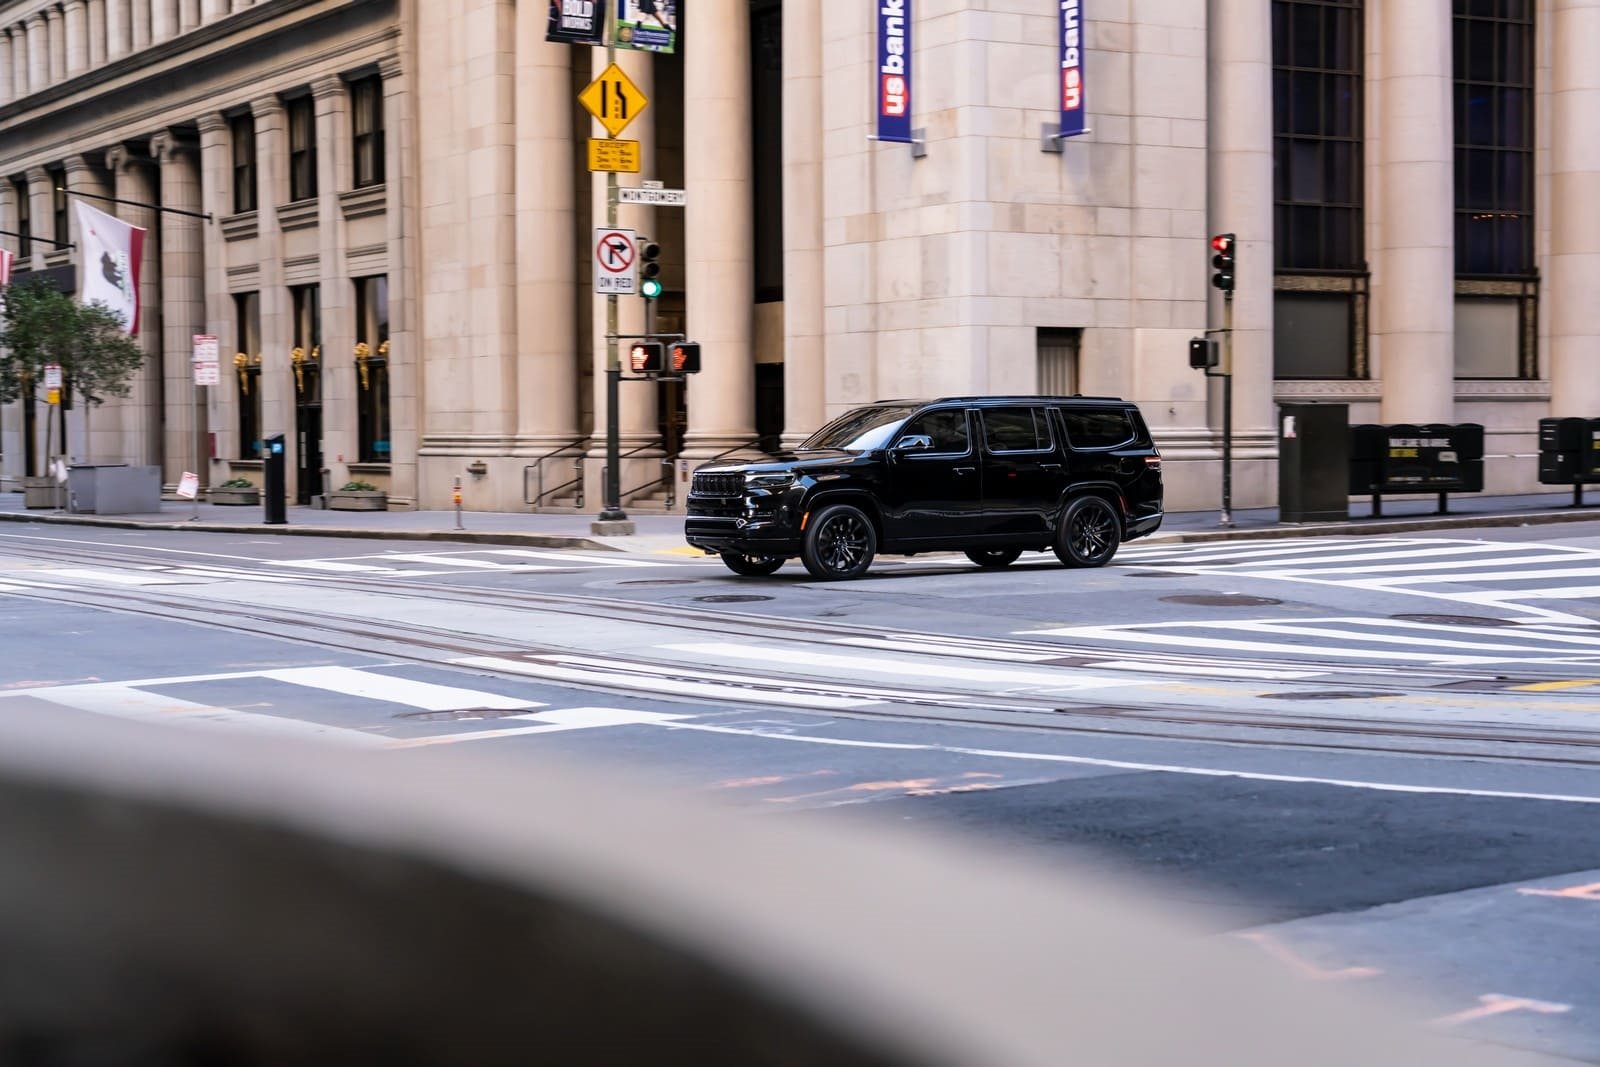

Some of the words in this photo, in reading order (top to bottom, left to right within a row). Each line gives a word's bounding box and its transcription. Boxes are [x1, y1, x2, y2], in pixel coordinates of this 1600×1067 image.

[622, 191, 683, 202] MONTGOMERY
[599, 277, 611, 288] ON
[615, 277, 632, 288] RED
